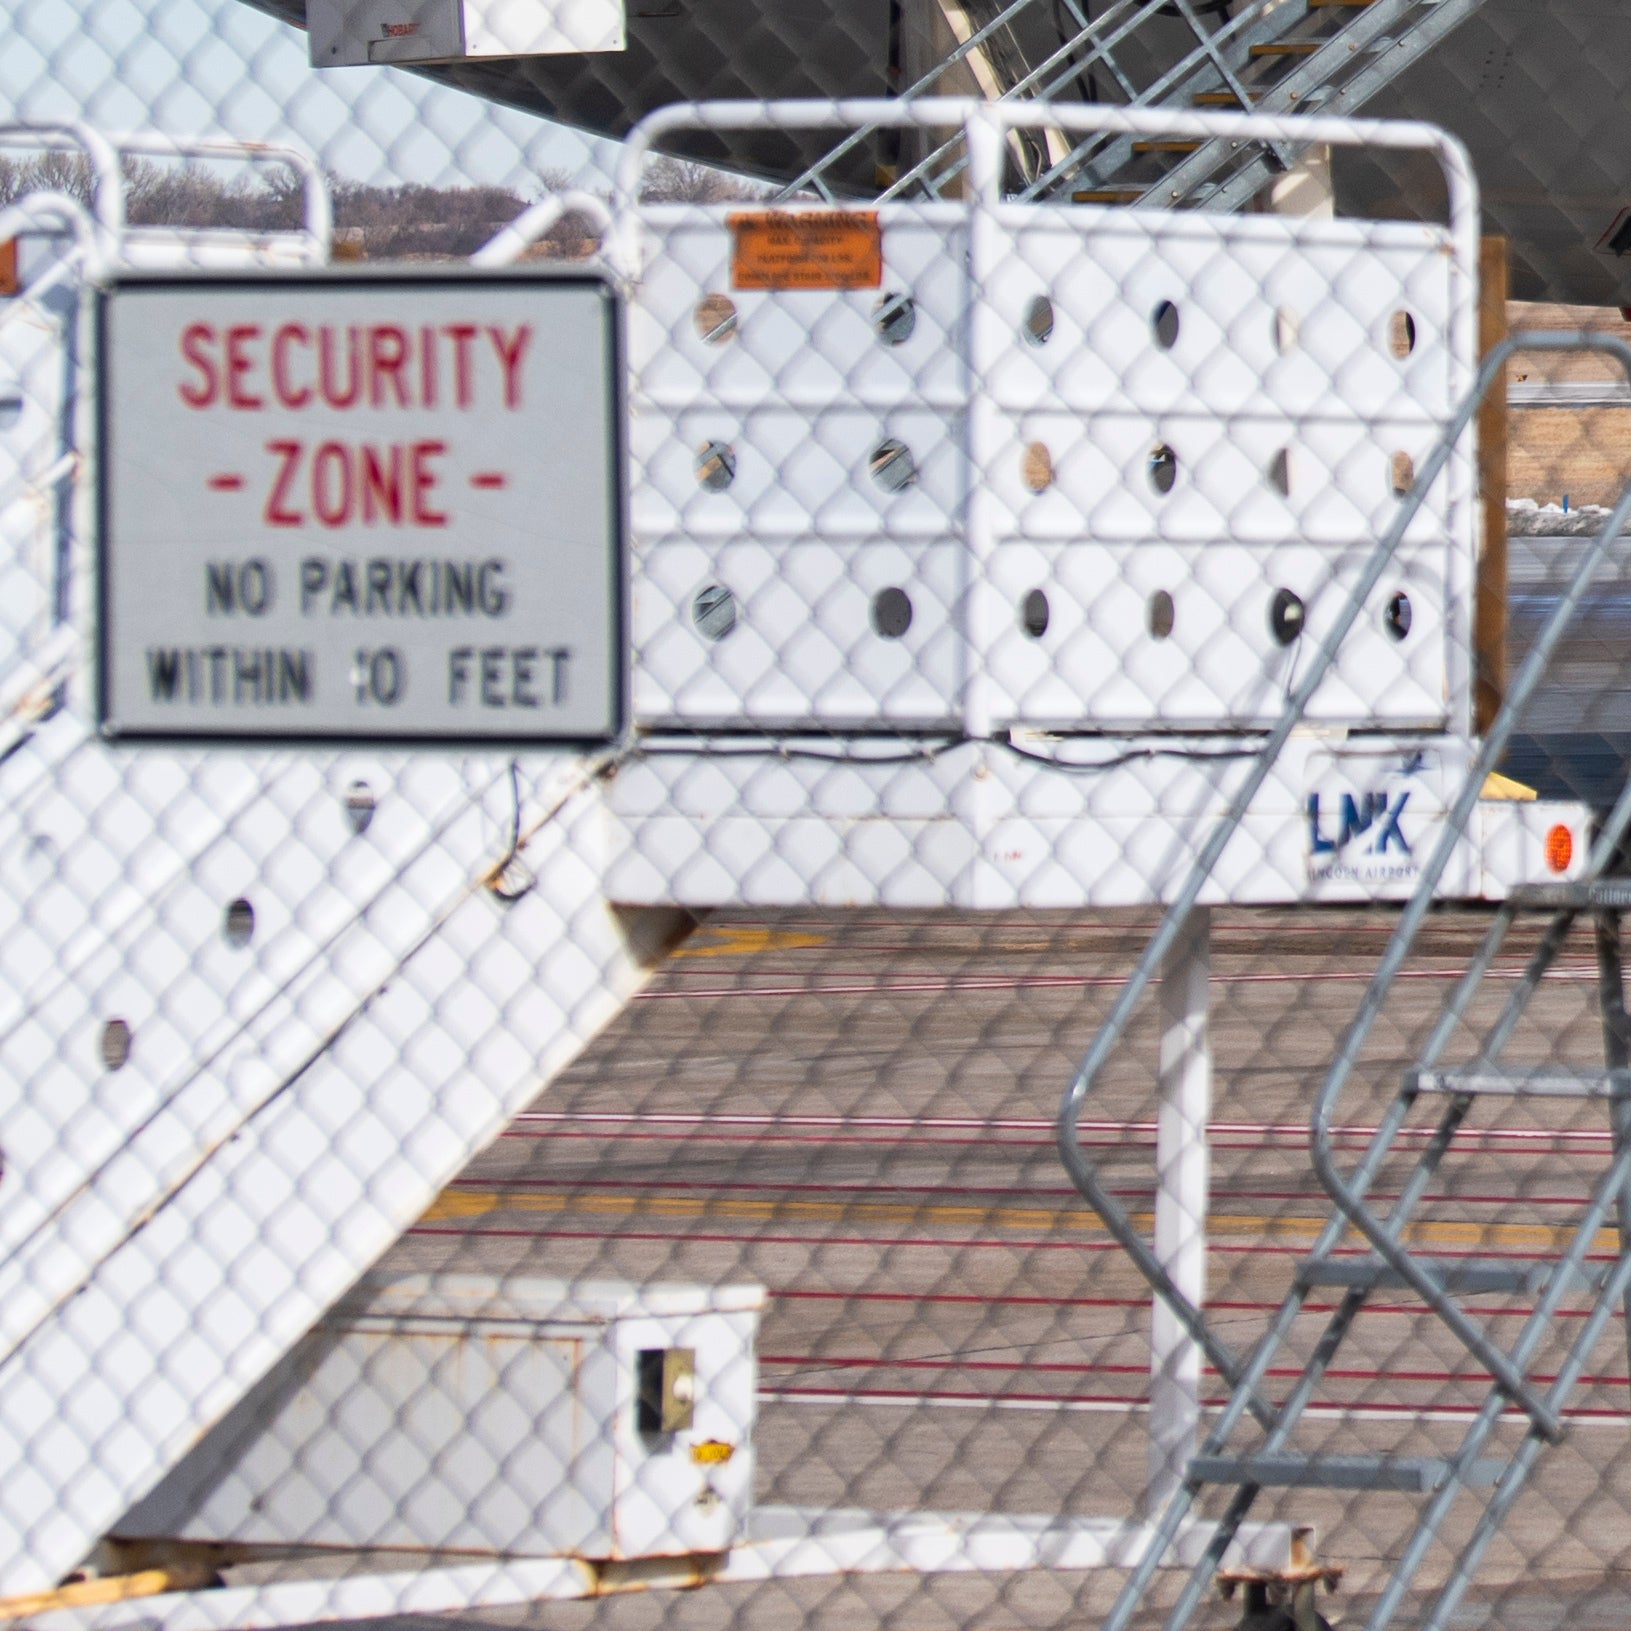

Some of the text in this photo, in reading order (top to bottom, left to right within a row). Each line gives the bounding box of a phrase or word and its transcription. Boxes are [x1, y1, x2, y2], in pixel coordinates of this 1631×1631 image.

[178, 322, 534, 412] SECURITY
[204, 558, 509, 619] NO PARKING
[146, 646, 578, 708] WITHIN 10 FEET
